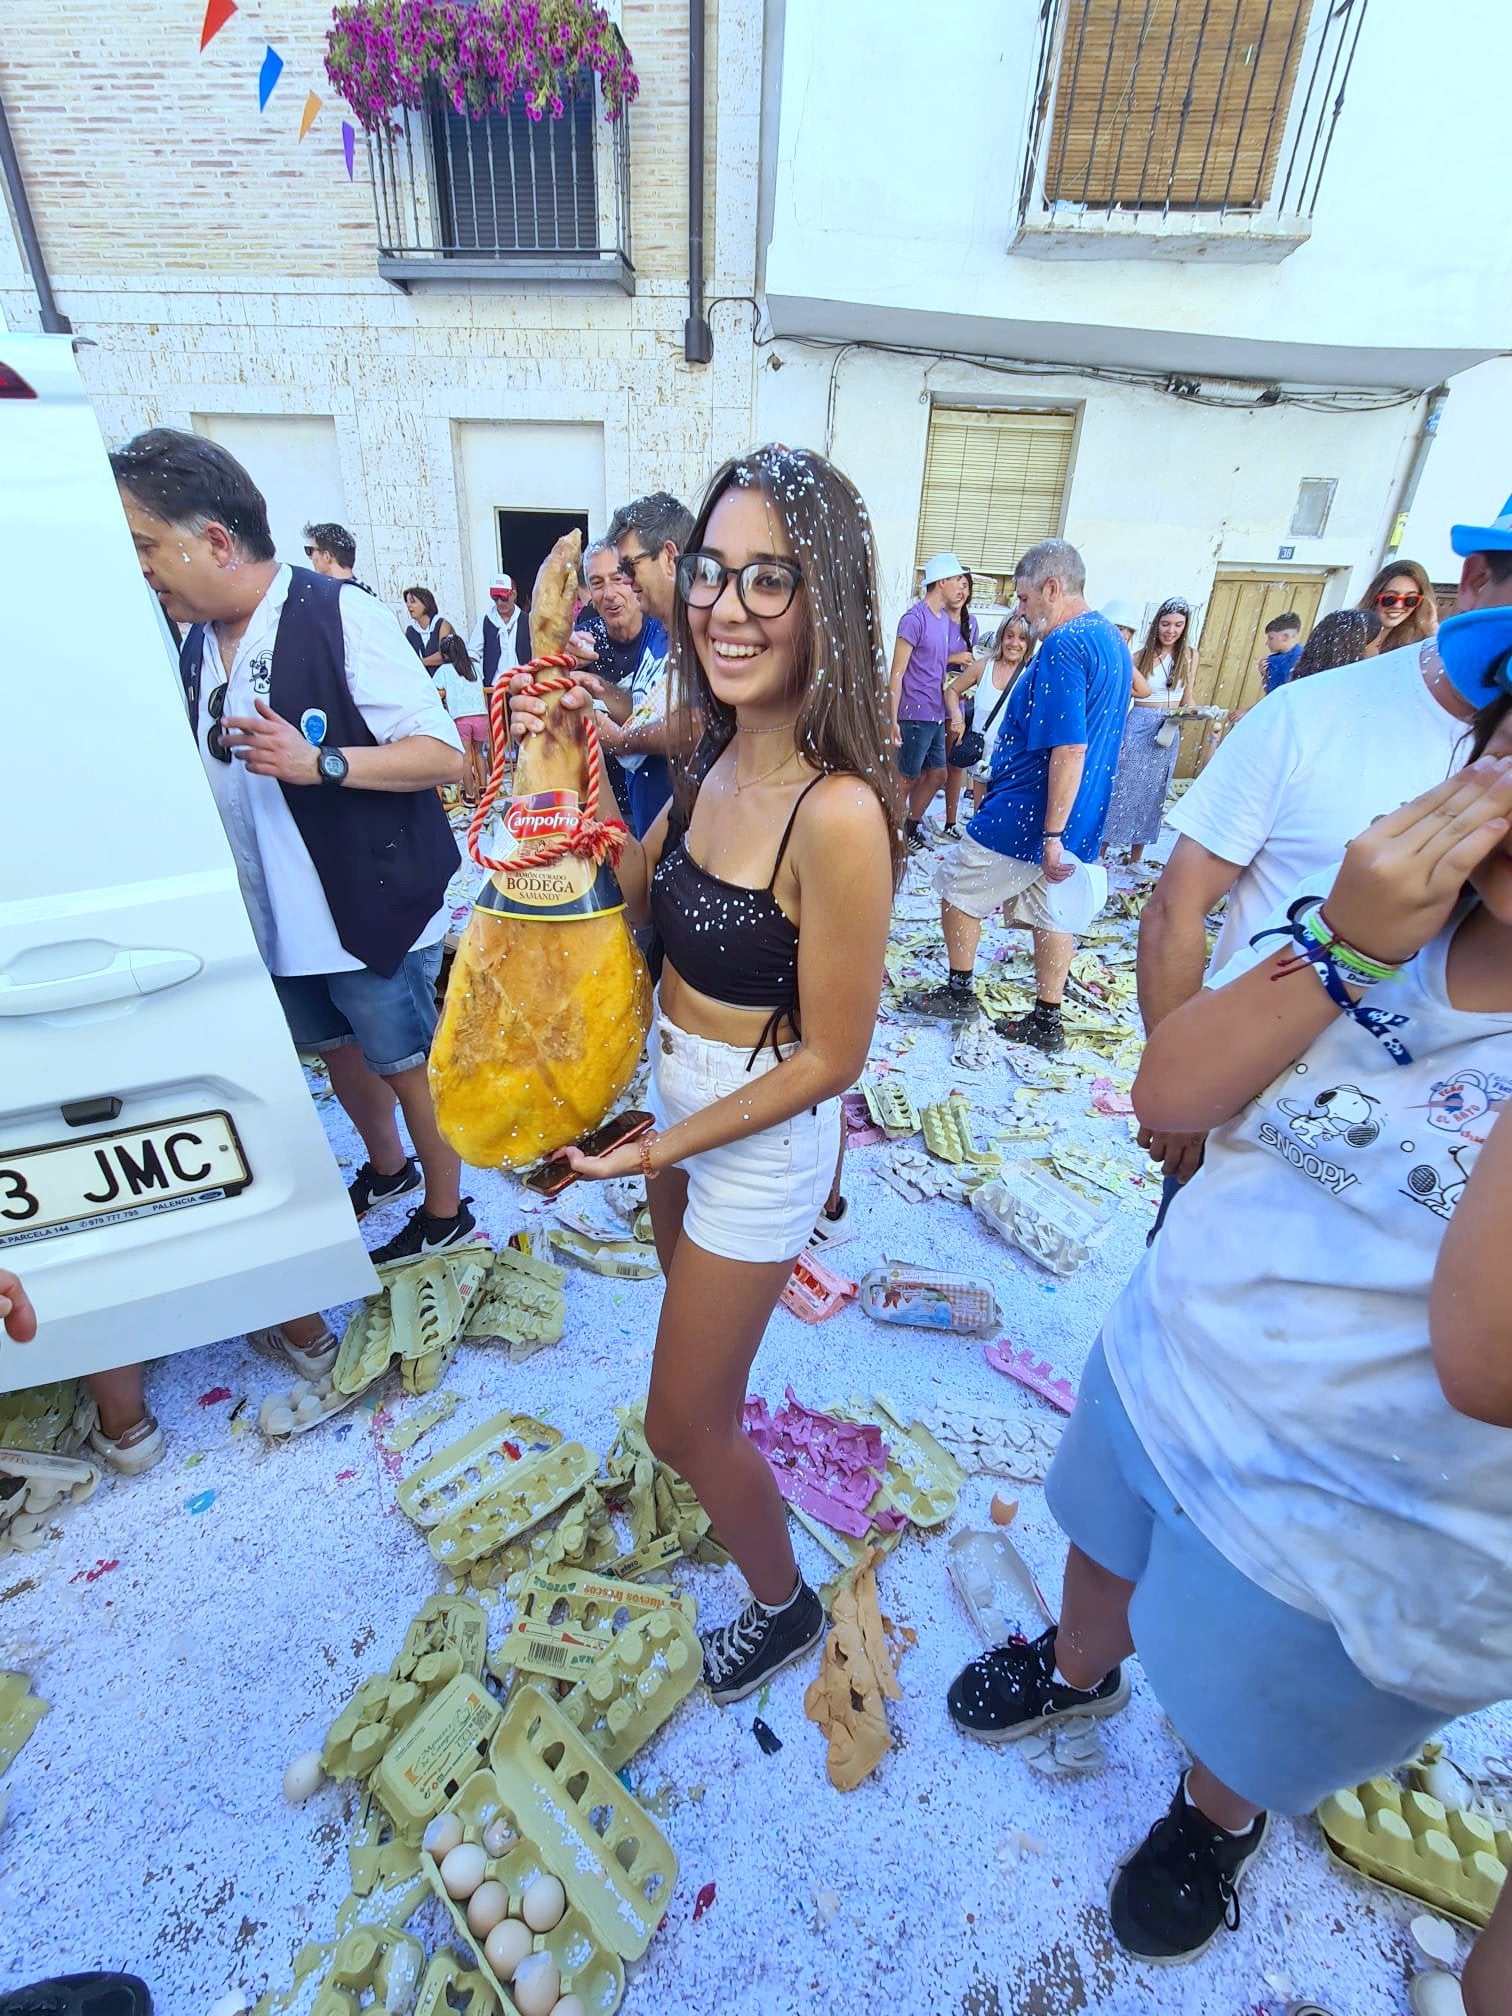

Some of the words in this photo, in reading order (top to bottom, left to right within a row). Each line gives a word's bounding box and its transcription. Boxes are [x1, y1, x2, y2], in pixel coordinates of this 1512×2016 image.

[507, 811, 579, 834] Campofrio
[507, 877, 575, 894] BODEGA
[83, 1132, 211, 1203] JMC
[1258, 1122, 1358, 1195] SNOOPY
[8, 1229, 52, 1243] PARCELA
[54, 1225, 70, 1233] 144
[152, 1196, 197, 1211] PALENCIA
